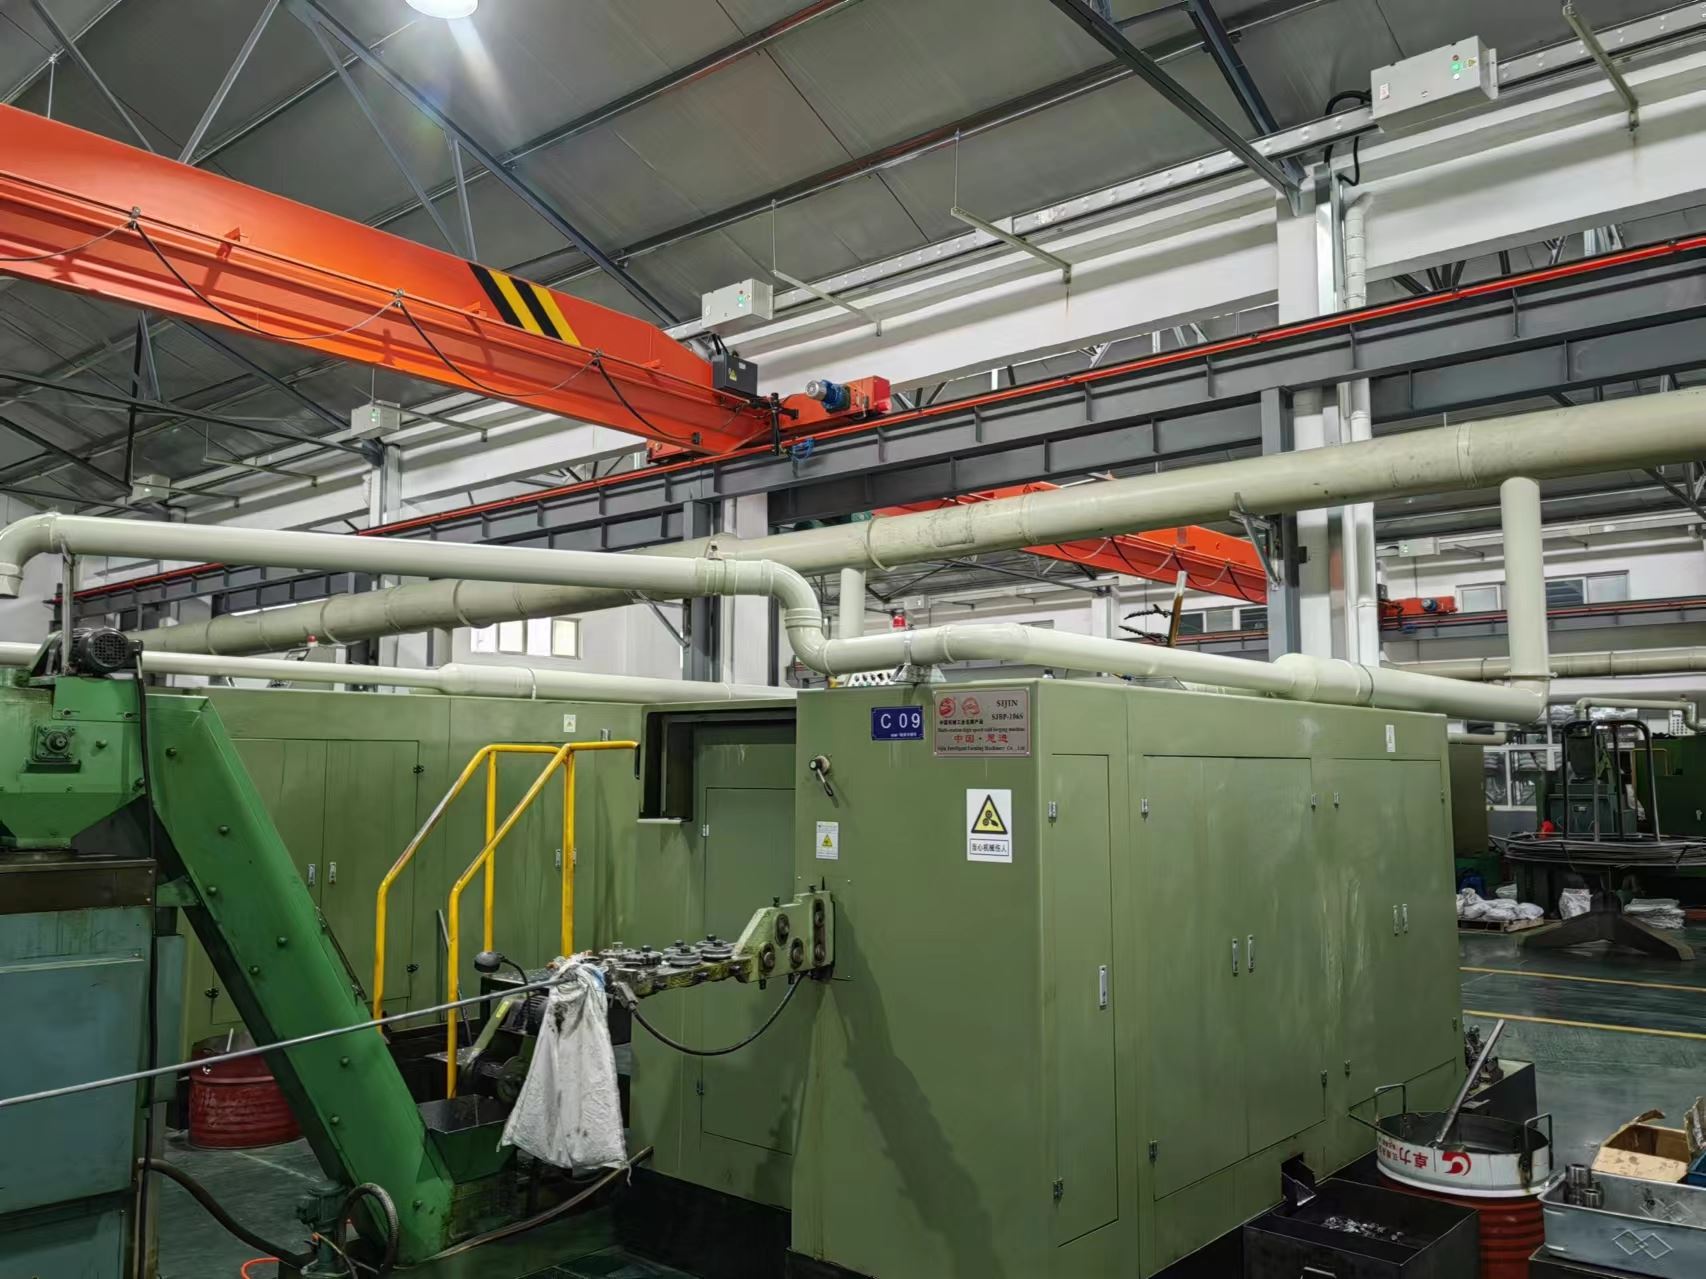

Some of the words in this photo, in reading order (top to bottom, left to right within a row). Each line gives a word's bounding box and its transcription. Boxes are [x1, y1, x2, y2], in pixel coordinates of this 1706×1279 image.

[996, 699, 1018, 709] SIJIN
[880, 713, 891, 729] C
[899, 712, 921, 728] 09
[972, 843, 1007, 852] 当心机械伤人
[1399, 1147, 1428, 1169] 卓力
